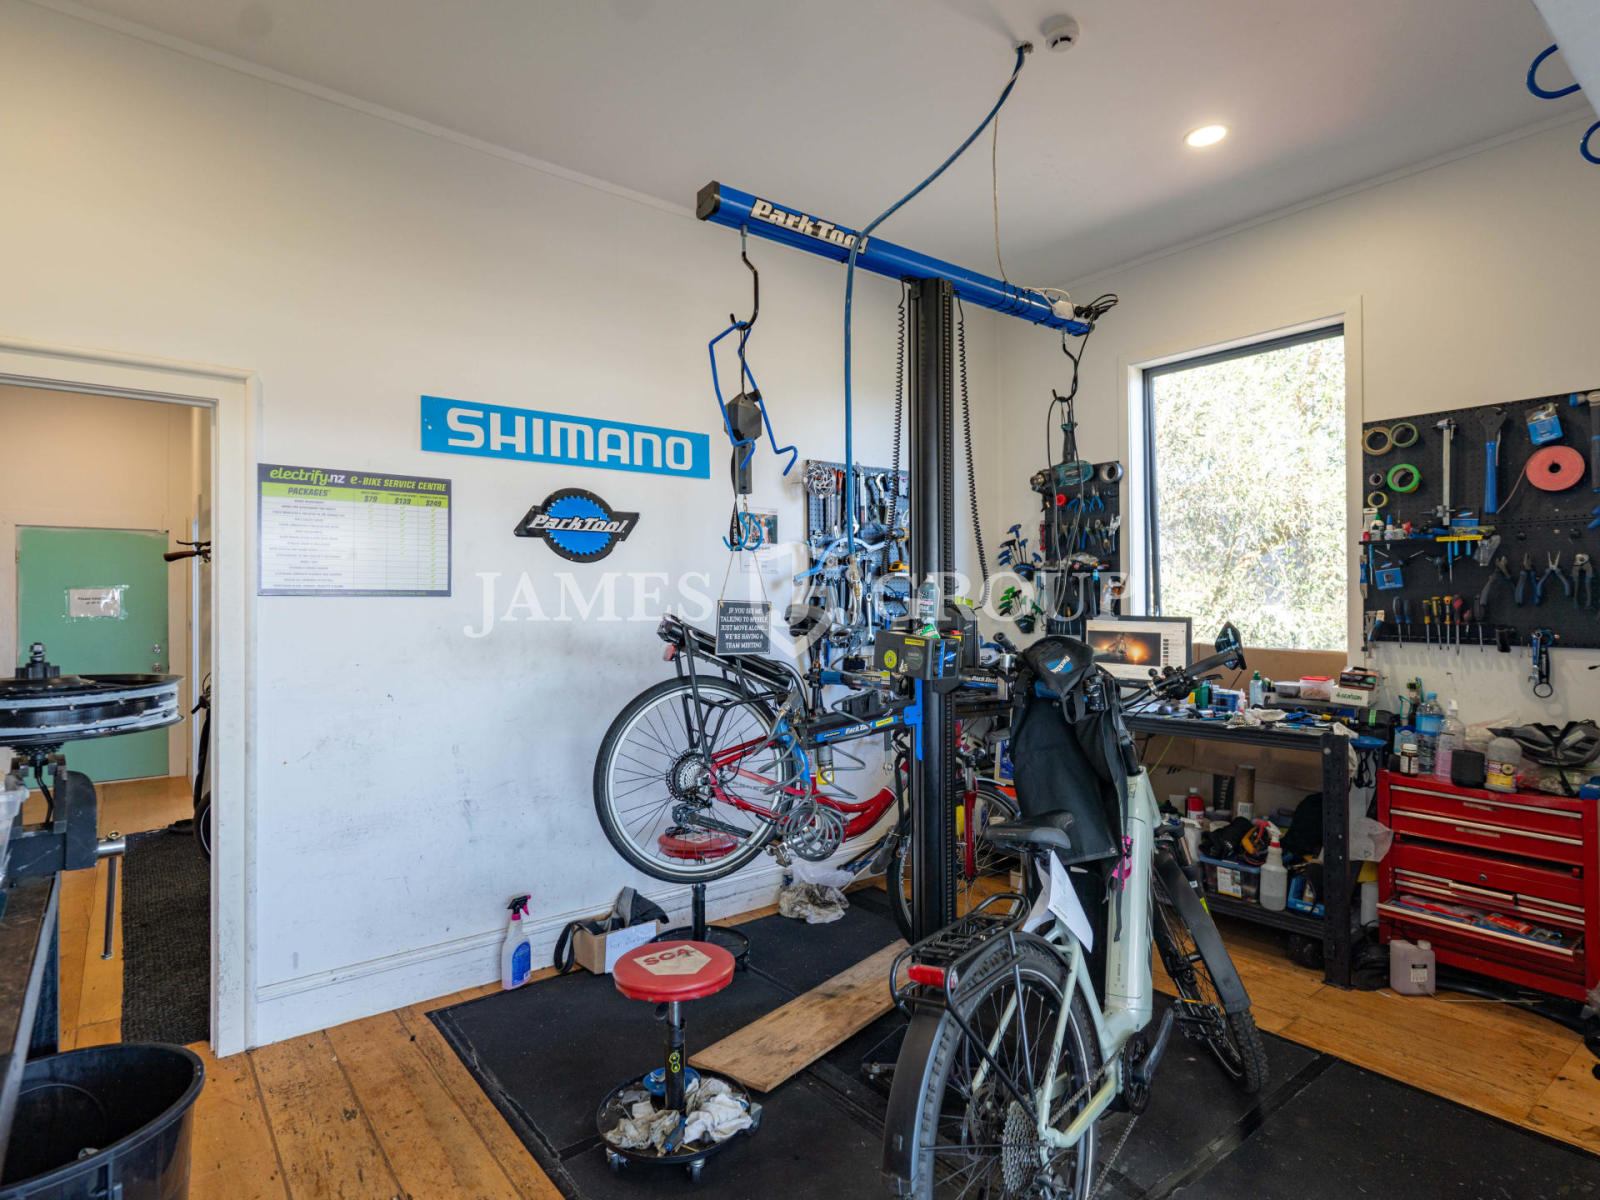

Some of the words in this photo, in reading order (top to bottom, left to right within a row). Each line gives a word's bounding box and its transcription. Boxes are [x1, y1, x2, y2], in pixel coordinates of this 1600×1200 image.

[446, 407, 693, 471] SHIMANO
[269, 467, 346, 486] electrify.nz
[383, 479, 417, 489] SERVICE
[418, 482, 447, 492] CENTRE
[288, 487, 329, 497] PACKAGES
